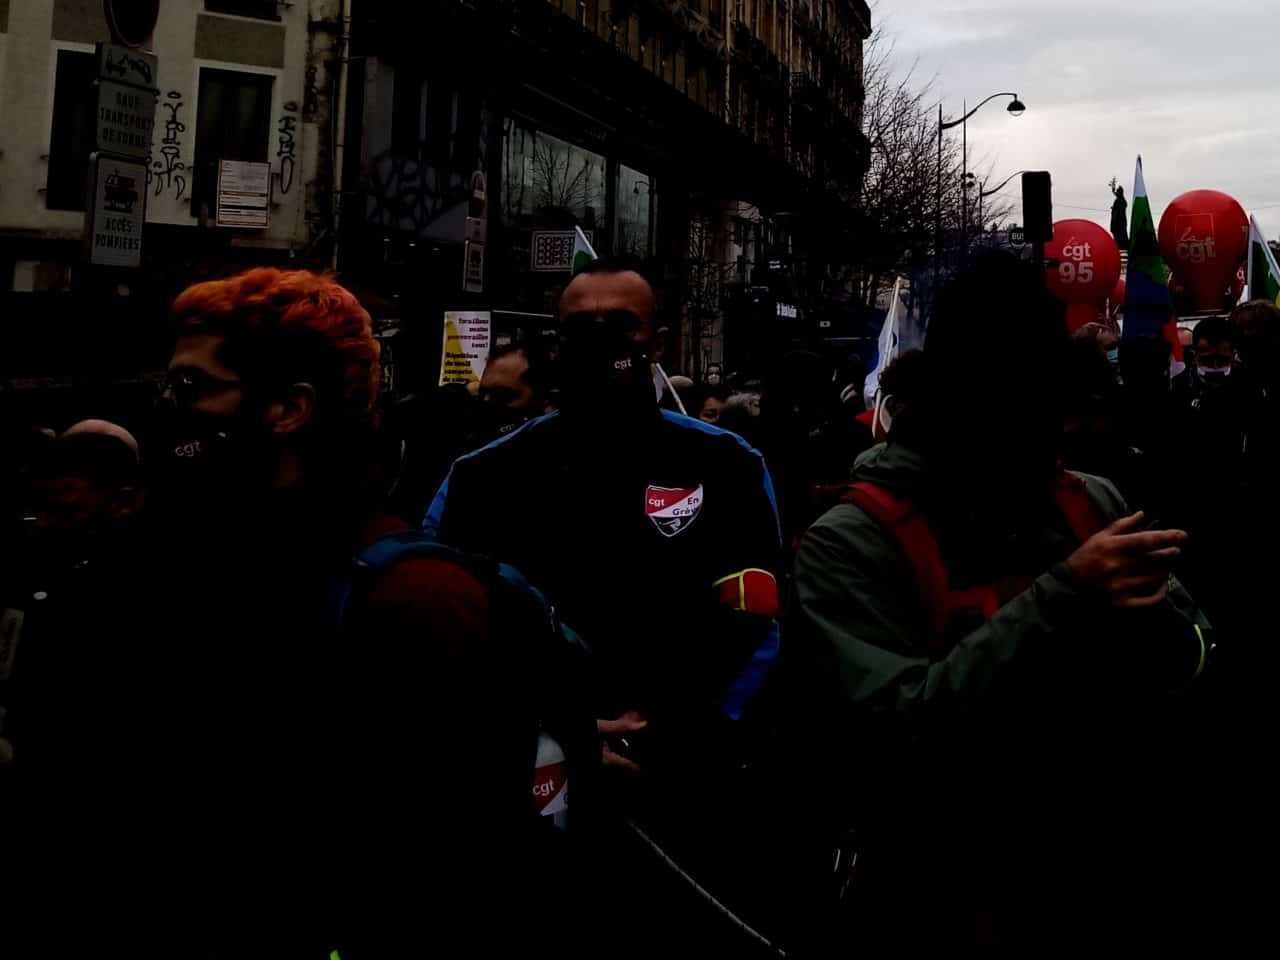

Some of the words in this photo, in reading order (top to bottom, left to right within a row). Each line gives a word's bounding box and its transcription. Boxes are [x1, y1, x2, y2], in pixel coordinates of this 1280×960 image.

[1062, 242, 1092, 261] cgt
[1176, 236, 1216, 264] cgt
[1058, 261, 1095, 284] 95
[613, 355, 633, 372] cgt
[648, 498, 665, 508] cgt
[688, 497, 699, 505] En
[531, 779, 555, 797] cgt
